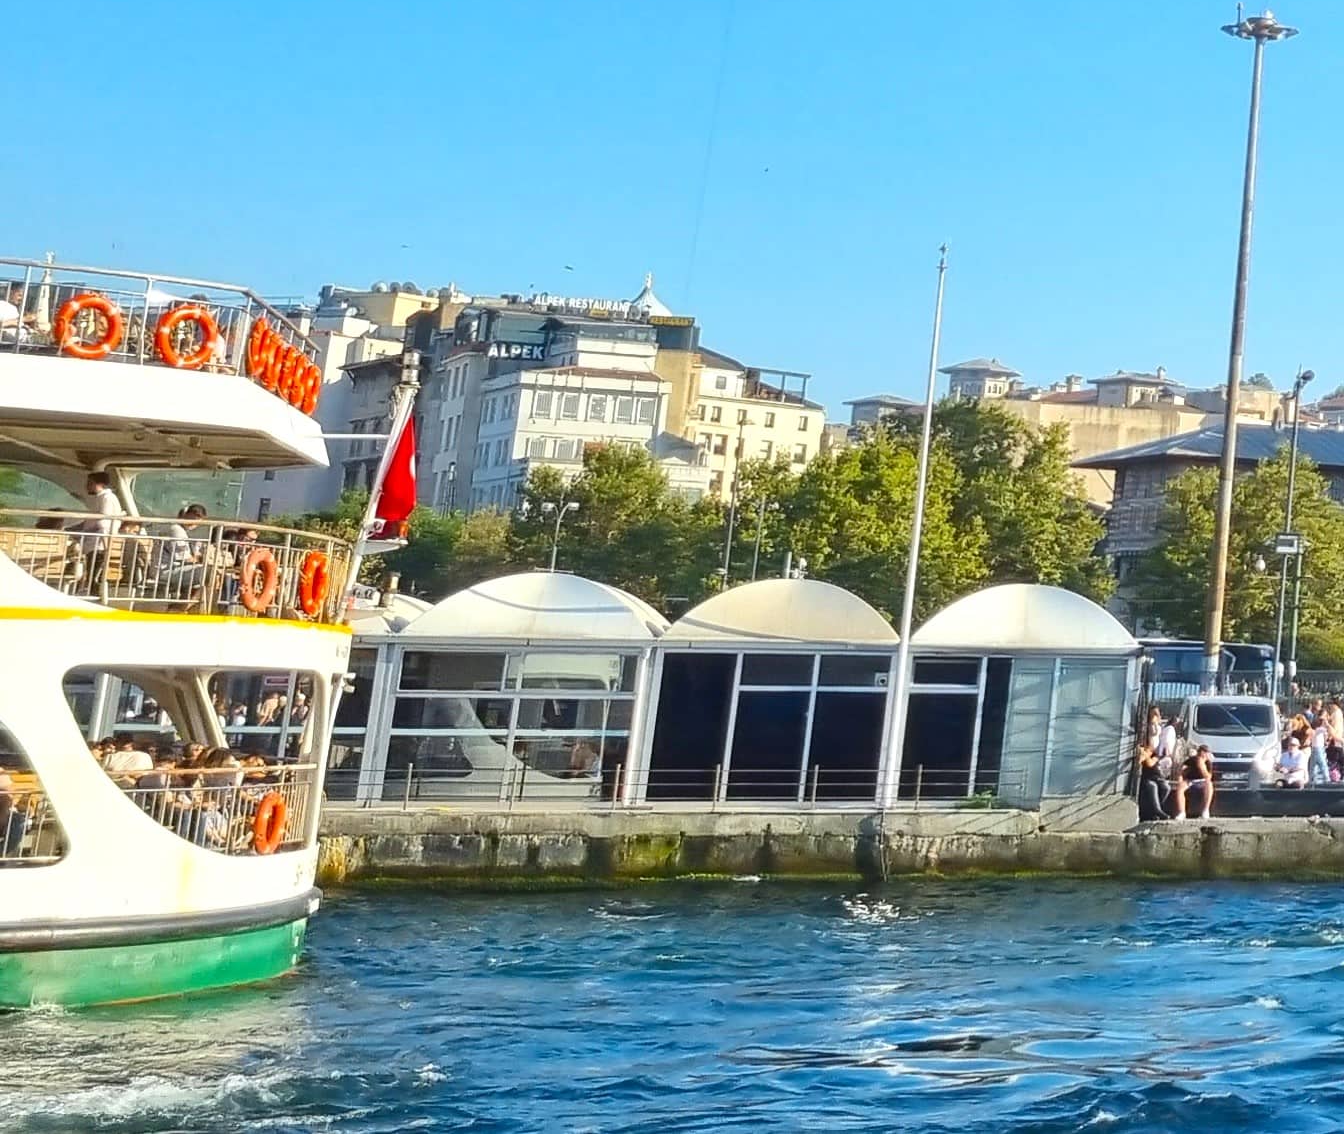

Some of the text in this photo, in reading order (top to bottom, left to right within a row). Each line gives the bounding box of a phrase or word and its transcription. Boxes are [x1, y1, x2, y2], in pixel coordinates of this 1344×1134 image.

[534, 295, 567, 307] ALPEK
[568, 297, 632, 313] RESTAURANT
[487, 344, 544, 359] ALPEK
